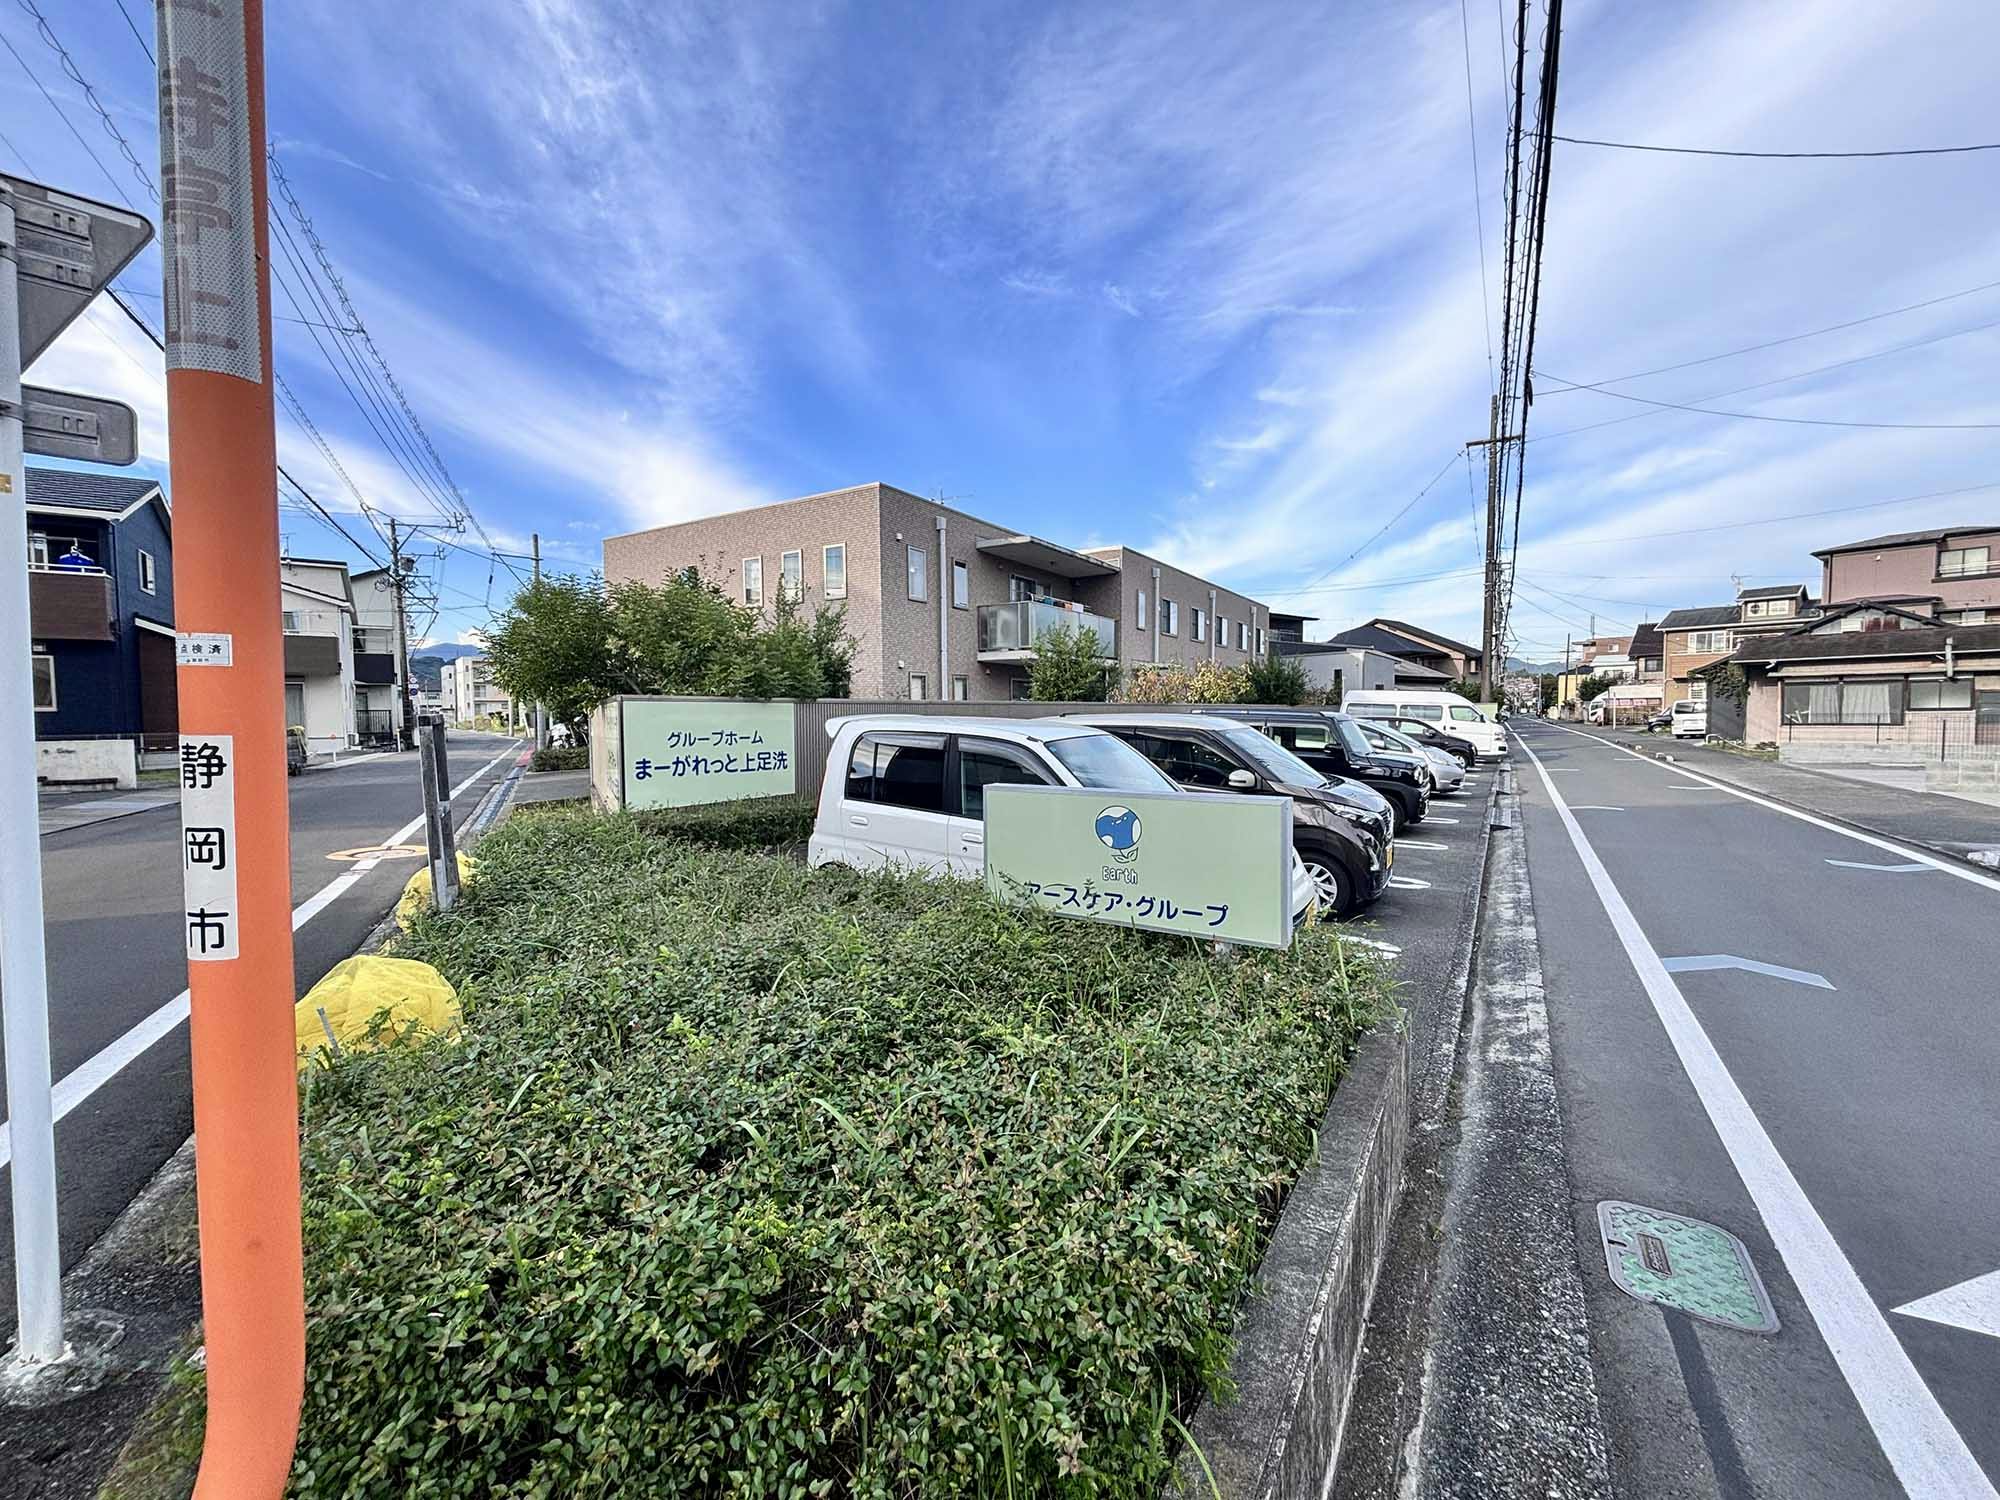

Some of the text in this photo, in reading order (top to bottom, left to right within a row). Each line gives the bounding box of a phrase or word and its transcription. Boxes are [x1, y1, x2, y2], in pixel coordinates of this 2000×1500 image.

[667, 730, 764, 748] グループホーム
[635, 751, 788, 780] まーがれっと上足洗
[181, 742, 229, 953] 静岡市
[1102, 866, 1139, 885] Earth
